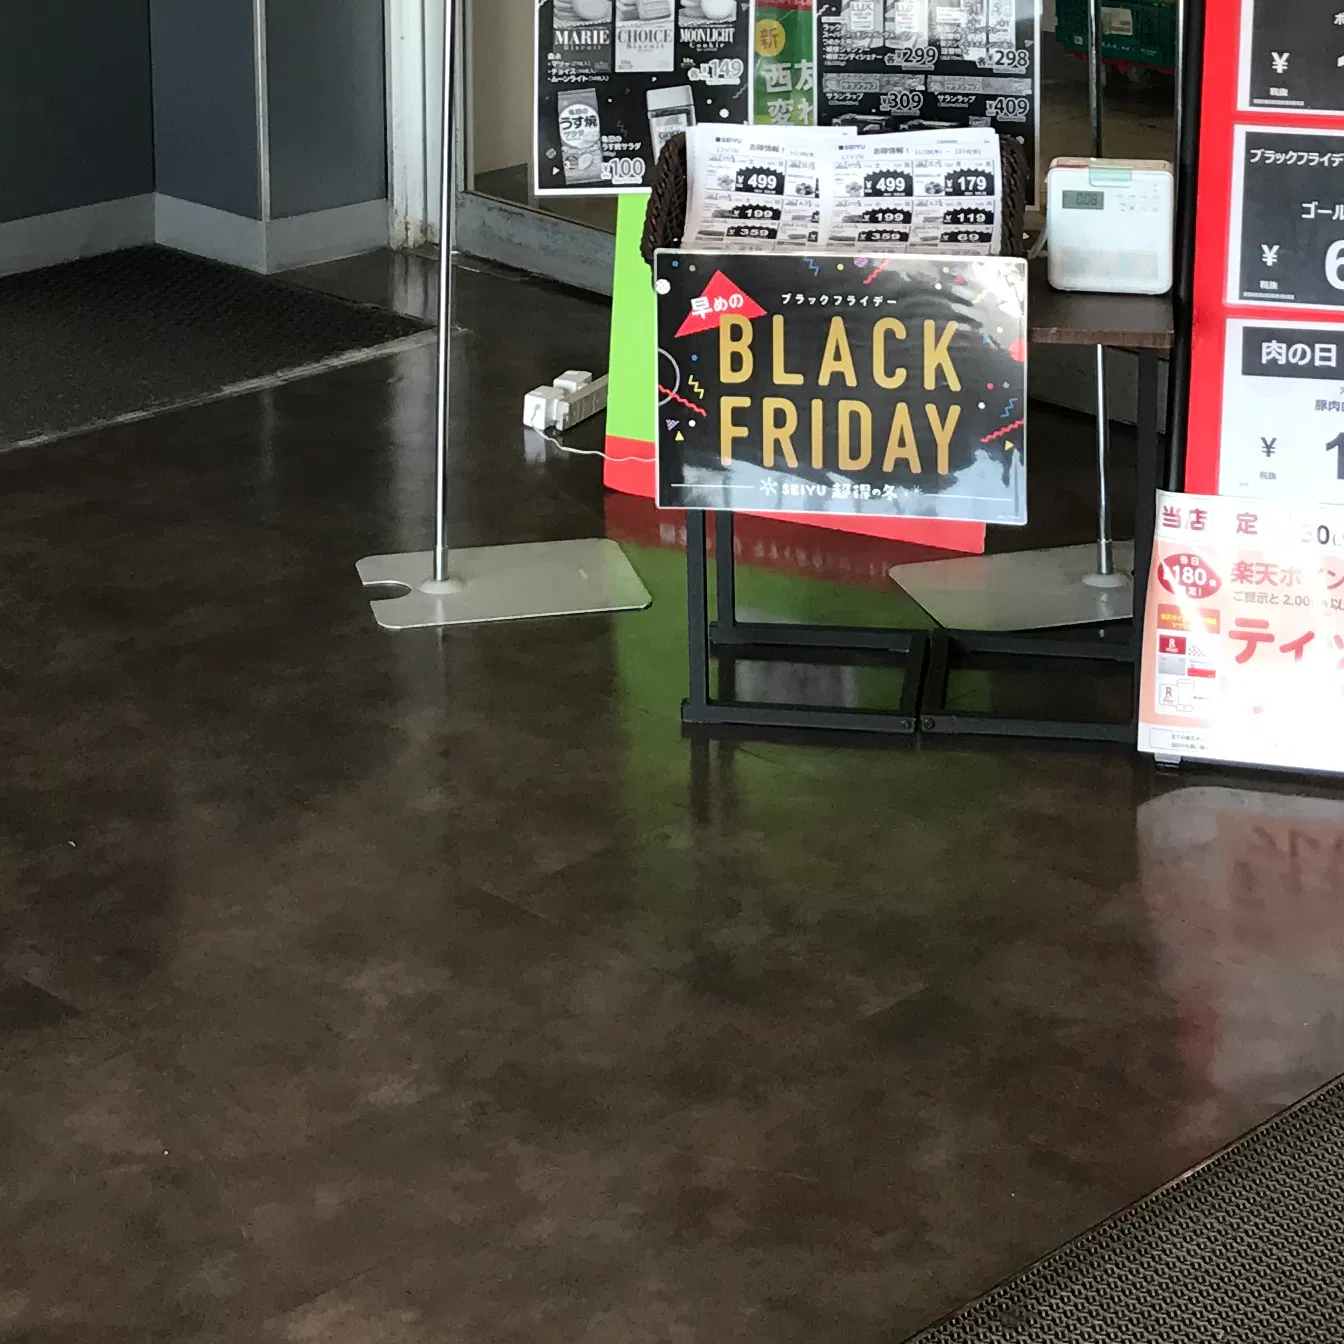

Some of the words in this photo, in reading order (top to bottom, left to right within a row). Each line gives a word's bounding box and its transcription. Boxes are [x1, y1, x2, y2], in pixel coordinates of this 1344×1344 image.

[555, 30, 610, 45] MARIE
[618, 29, 672, 43] CHOICE
[680, 28, 735, 43] MOONLIGHT
[759, 27, 778, 49] 新
[560, 116, 597, 130] うす焼
[748, 174, 777, 189] 499
[876, 177, 905, 191] 499
[958, 176, 987, 190] 179
[691, 293, 744, 317] 早めの
[780, 293, 897, 309] ブラックフライデー
[718, 314, 962, 392] BLACK
[1260, 340, 1338, 368] 肉の日
[718, 396, 962, 476] FRIDAY
[782, 484, 827, 497] SEIYU
[832, 482, 898, 500] 超得の冬
